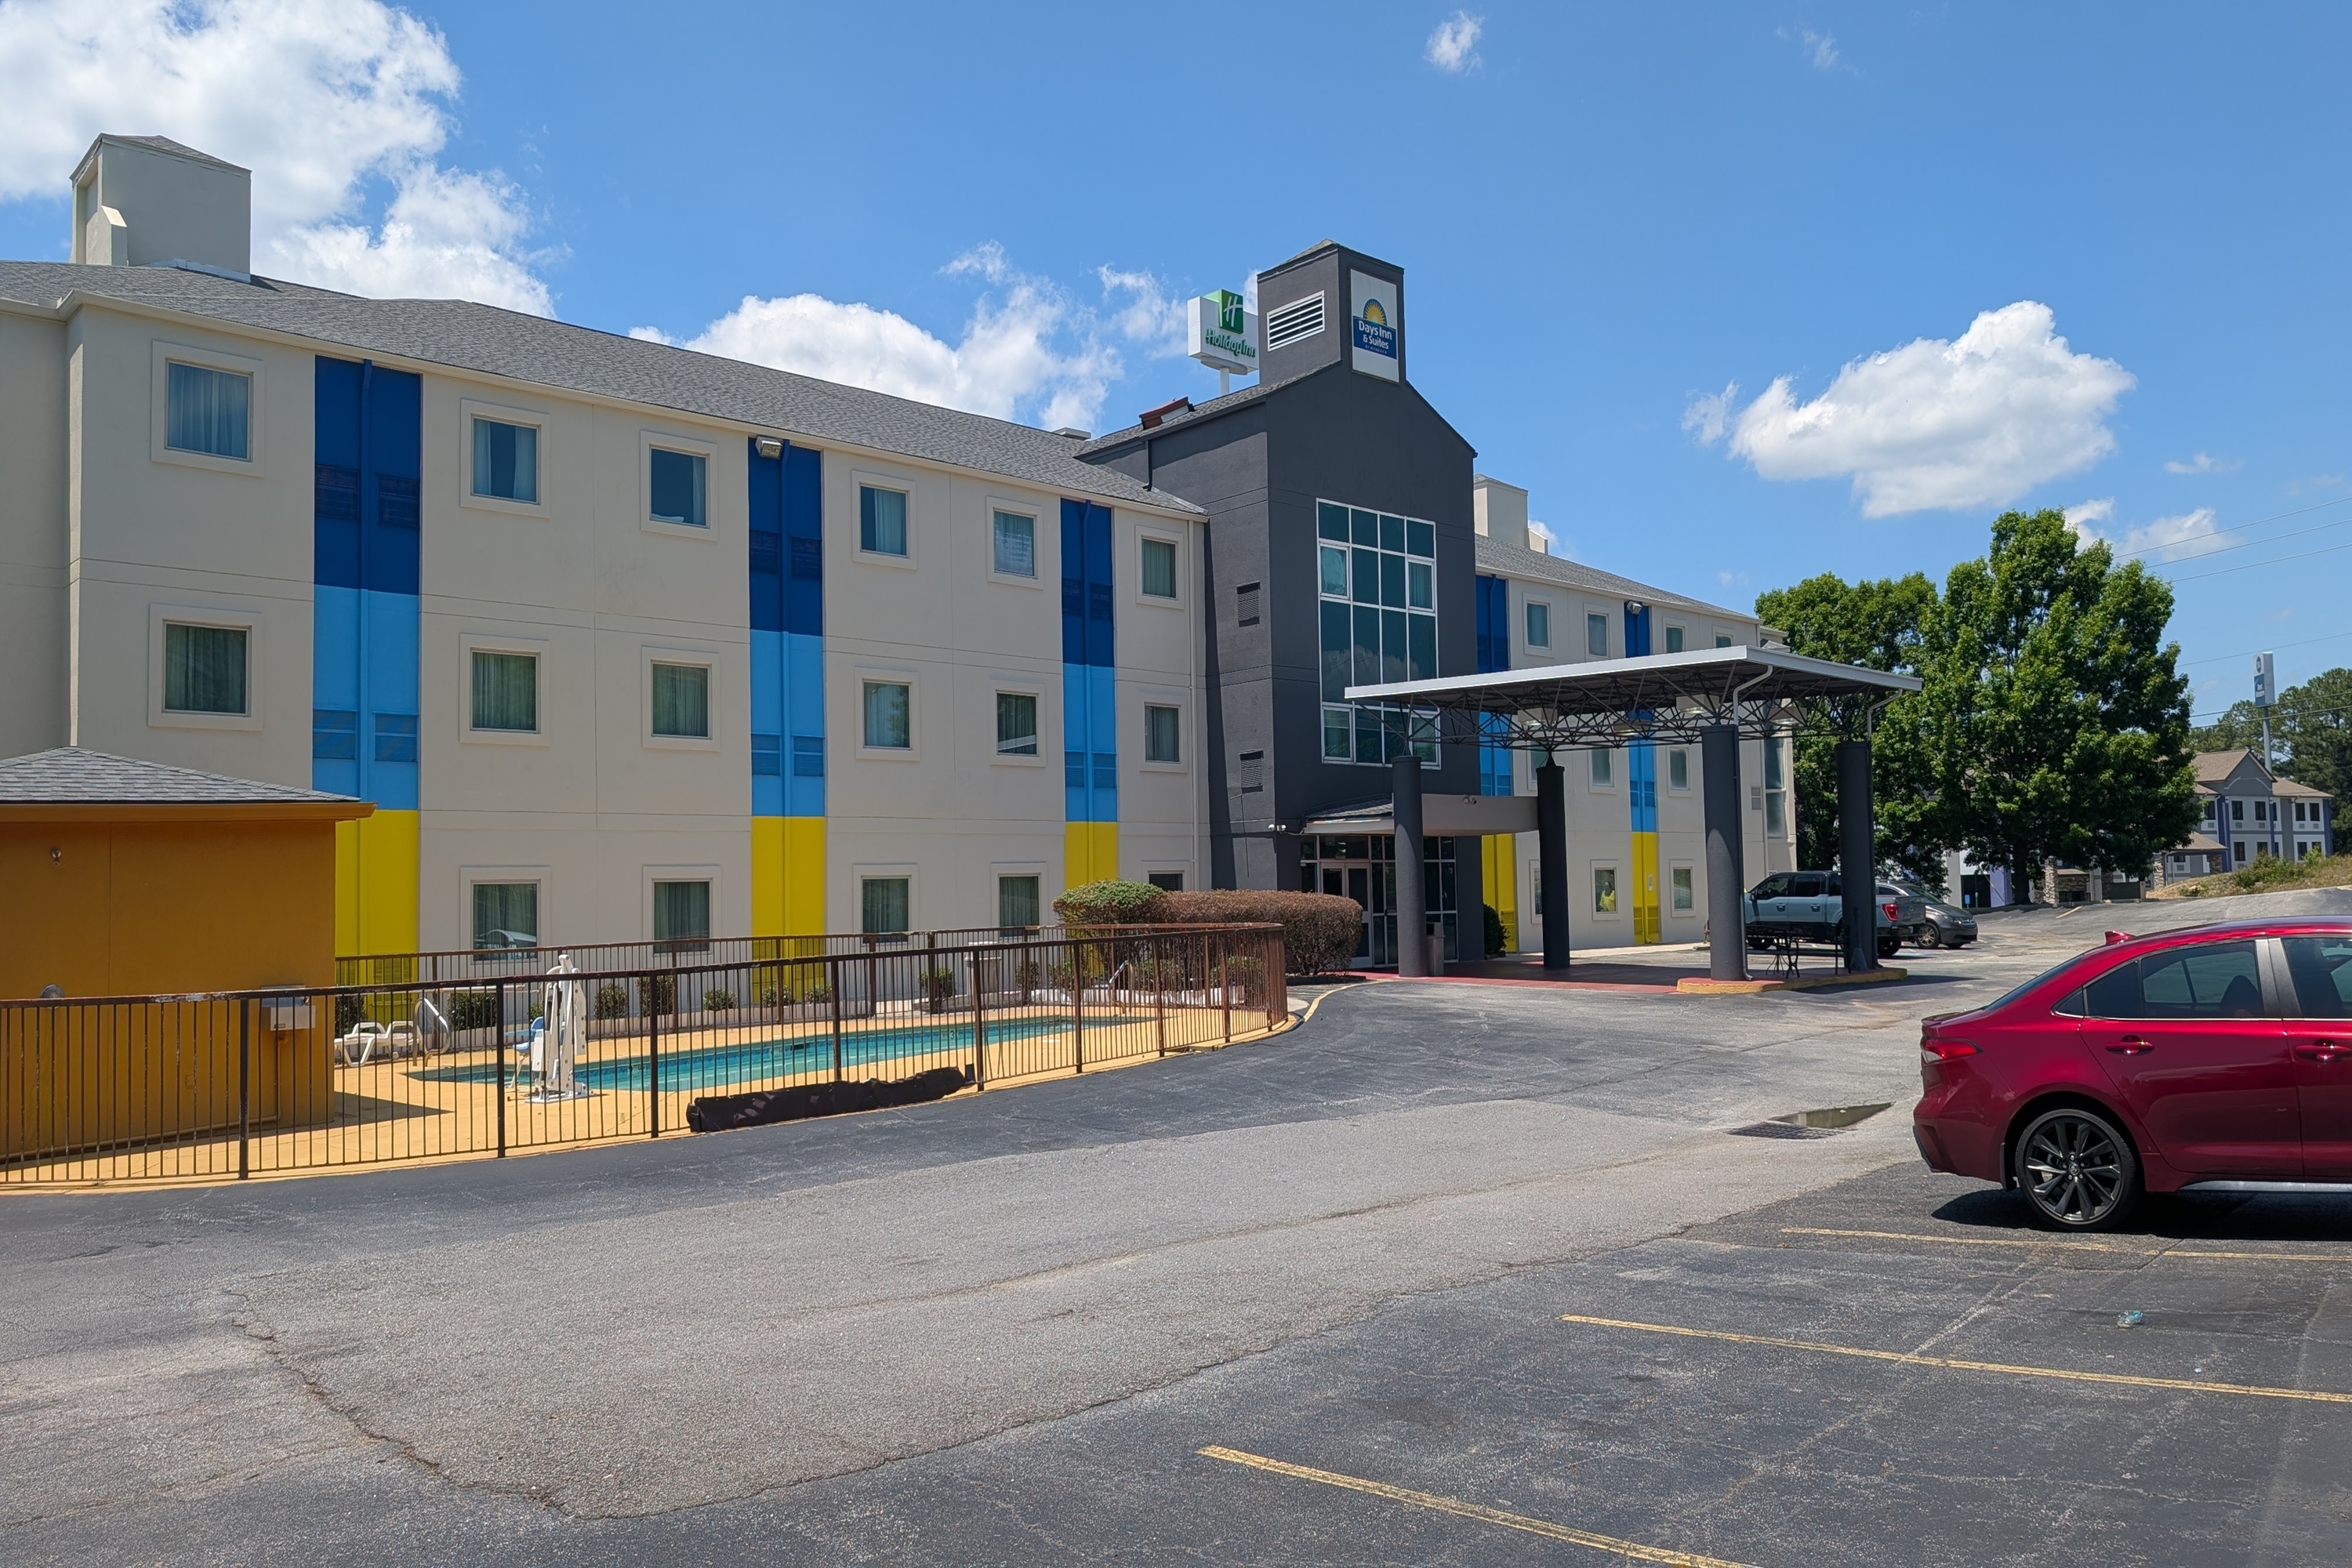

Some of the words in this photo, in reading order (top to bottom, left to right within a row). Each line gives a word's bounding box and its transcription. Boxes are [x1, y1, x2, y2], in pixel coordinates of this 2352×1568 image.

[1359, 320, 1378, 336] Days
[1380, 327, 1392, 340] Inn
[1205, 328, 1242, 357] Holiday
[1241, 339, 1256, 358] Inn
[1363, 334, 1368, 343] &
[1368, 335, 1389, 349] Suites
